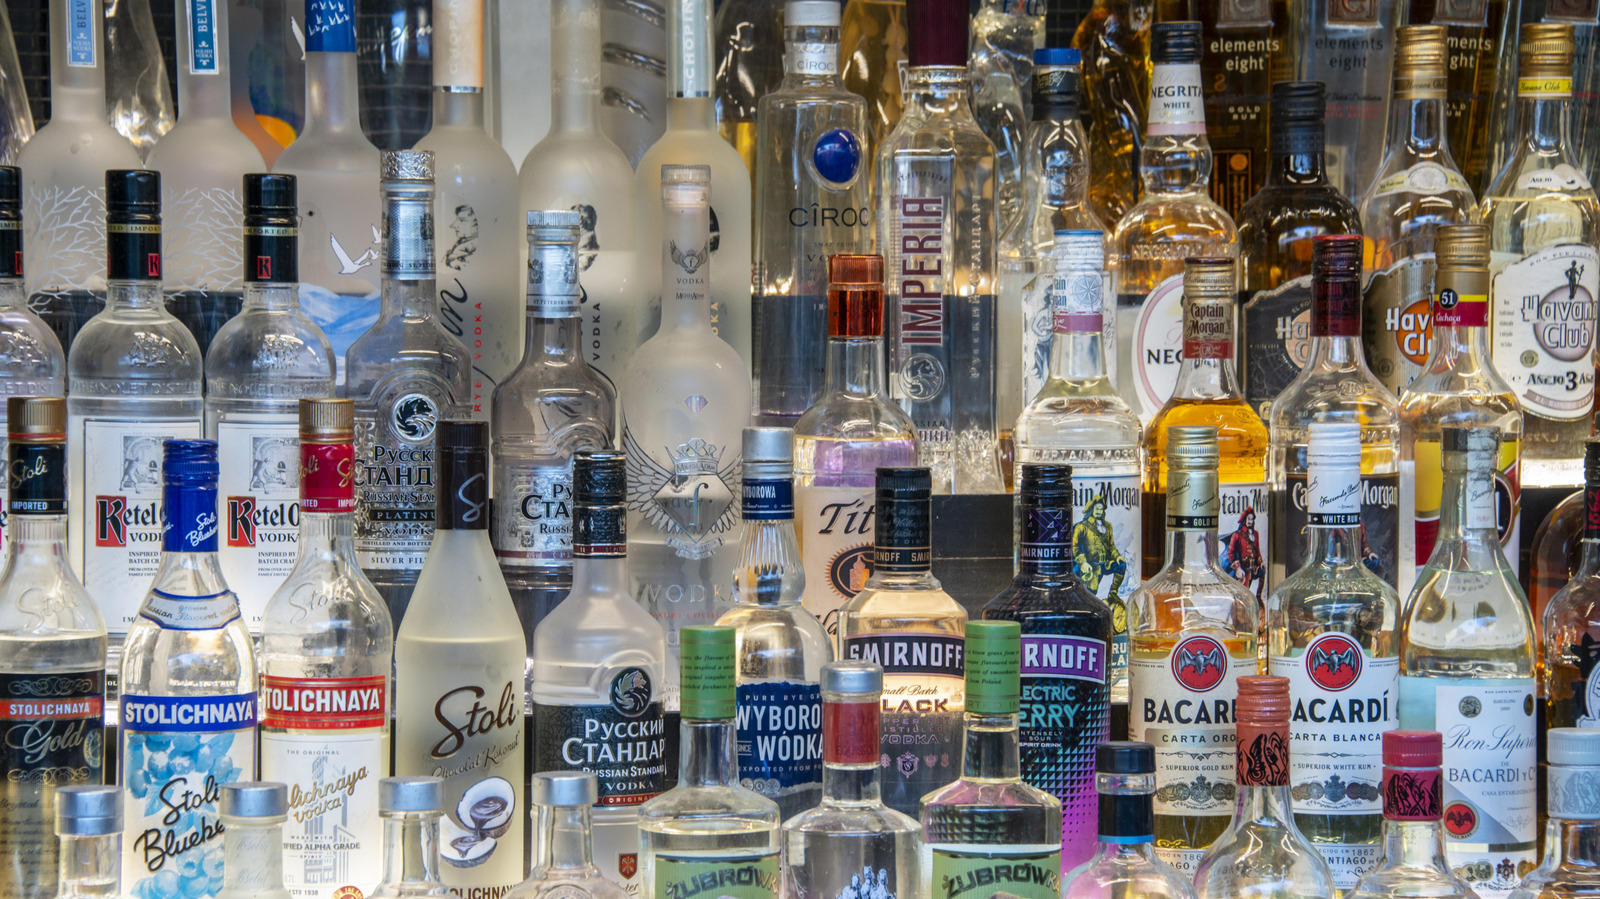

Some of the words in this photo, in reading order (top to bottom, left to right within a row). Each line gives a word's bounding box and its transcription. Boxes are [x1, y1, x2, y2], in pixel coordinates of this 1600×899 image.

[1210, 38, 1279, 53] elements
[1315, 36, 1383, 50] elements
[797, 59, 834, 71] CÎROC
[1225, 56, 1264, 72] eight
[1330, 53, 1367, 70] eight
[789, 202, 869, 228] CÎROC
[1442, 291, 1456, 306] 51
[1190, 303, 1224, 320] Captain
[1436, 311, 1461, 324] Cachaça
[474, 302, 483, 360] VODKA
[592, 303, 601, 361] VODKA
[1187, 320, 1226, 338] Morgan
[1543, 323, 1590, 349] Club
[1565, 371, 1577, 391] 3
[474, 382, 483, 412] RYE
[10, 455, 48, 489] Stoli
[11, 501, 48, 510] IMPORTED
[96, 498, 156, 545] Ketel
[196, 511, 217, 531] Stoli
[228, 498, 285, 545] Ketel
[1193, 518, 1210, 527] GOLD
[1322, 514, 1346, 524] WHITE
[1347, 514, 1359, 523] RUM
[850, 642, 963, 669] SMIRNOFF
[1020, 643, 1099, 672] RNOFF
[745, 694, 776, 702] PURE
[783, 693, 803, 701] RYE
[882, 685, 907, 696] mall
[907, 684, 938, 696] Batch
[9, 702, 91, 716] STOLICHNAYA
[263, 689, 381, 713] TOLICHNAYA
[1289, 688, 1389, 724] ACARDÍ
[125, 700, 254, 725] STOLICHNAYA
[430, 680, 518, 759] Stoli
[4, 716, 87, 764] Gold
[880, 734, 939, 745] VODKA
[1161, 734, 1207, 743] CARTA
[1212, 733, 1237, 743] ORO
[1333, 733, 1382, 742] BLANCA
[1442, 723, 1486, 750] Ron
[737, 744, 752, 753] SINCE
[756, 730, 823, 762] WÓDKA
[430, 753, 481, 779] Chocolat
[1297, 763, 1331, 771] SUPERIOR
[1448, 767, 1519, 783] BACARDI
[287, 764, 368, 811] lichnaya
[605, 780, 654, 791] VODKA
[158, 774, 220, 826] Stoli
[292, 796, 343, 824] vodka
[304, 841, 331, 850] ALPHA
[332, 841, 361, 850] GRADE
[1352, 848, 1375, 856] 1862
